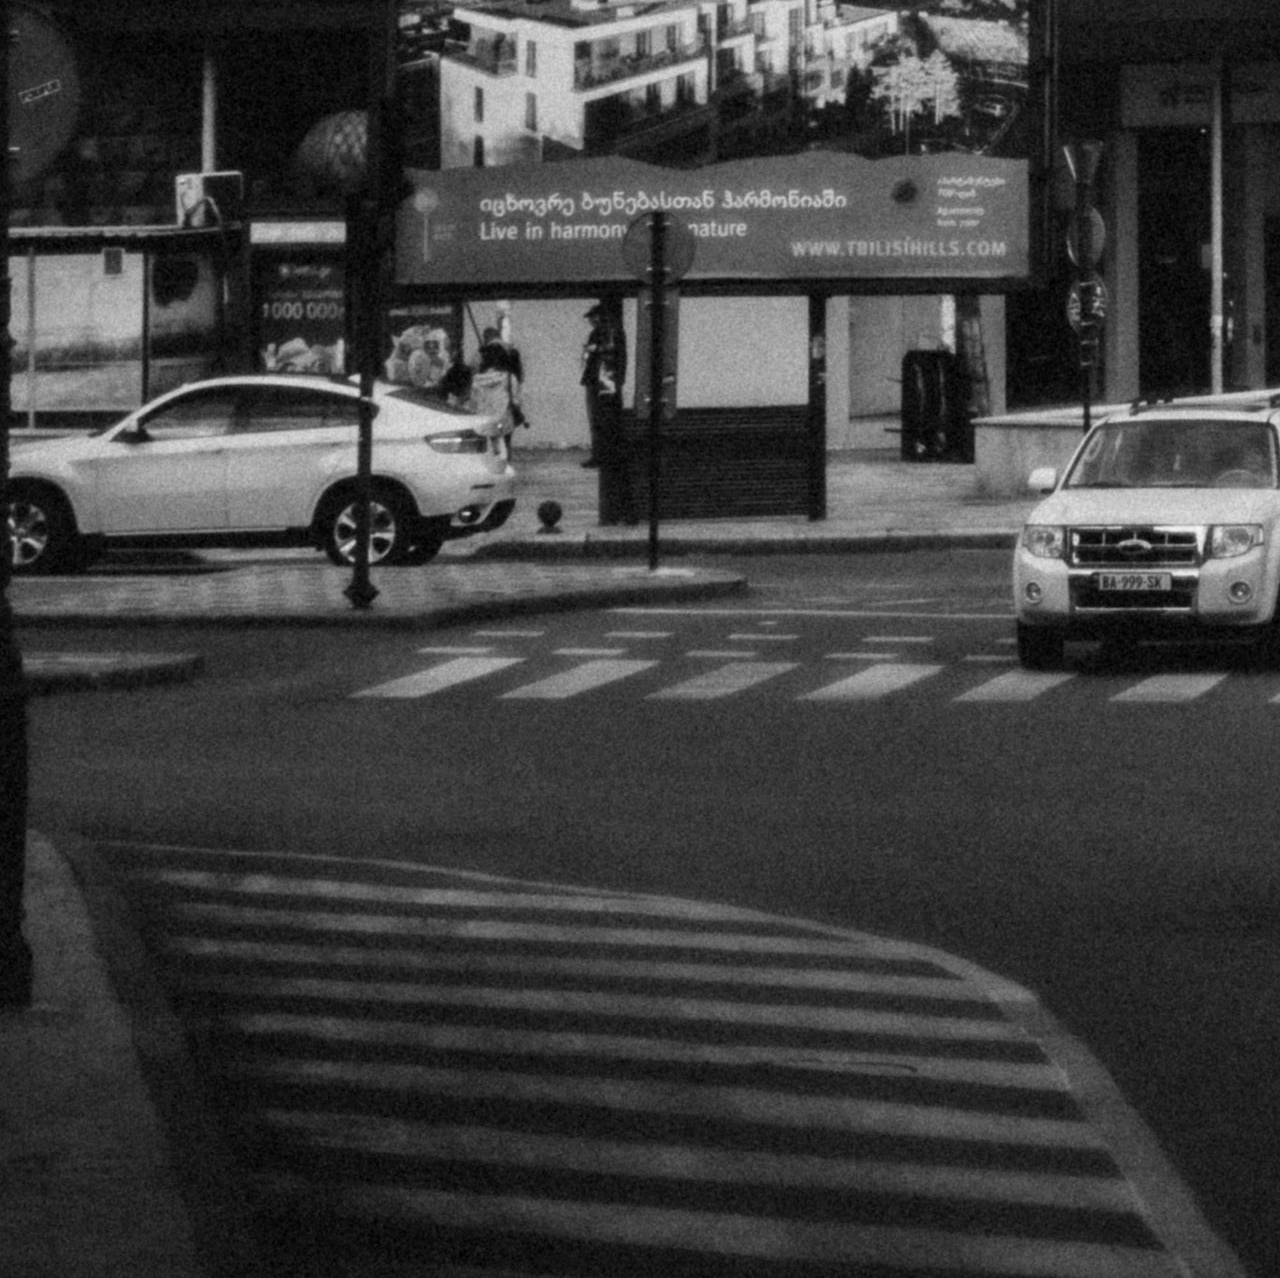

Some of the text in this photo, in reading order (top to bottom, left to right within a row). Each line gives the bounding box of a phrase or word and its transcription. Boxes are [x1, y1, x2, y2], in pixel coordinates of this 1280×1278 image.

[479, 188, 847, 217] იცხოვრე ბუნებასთან ჰარმონიაში
[480, 222, 518, 240] Live
[525, 221, 543, 240] in
